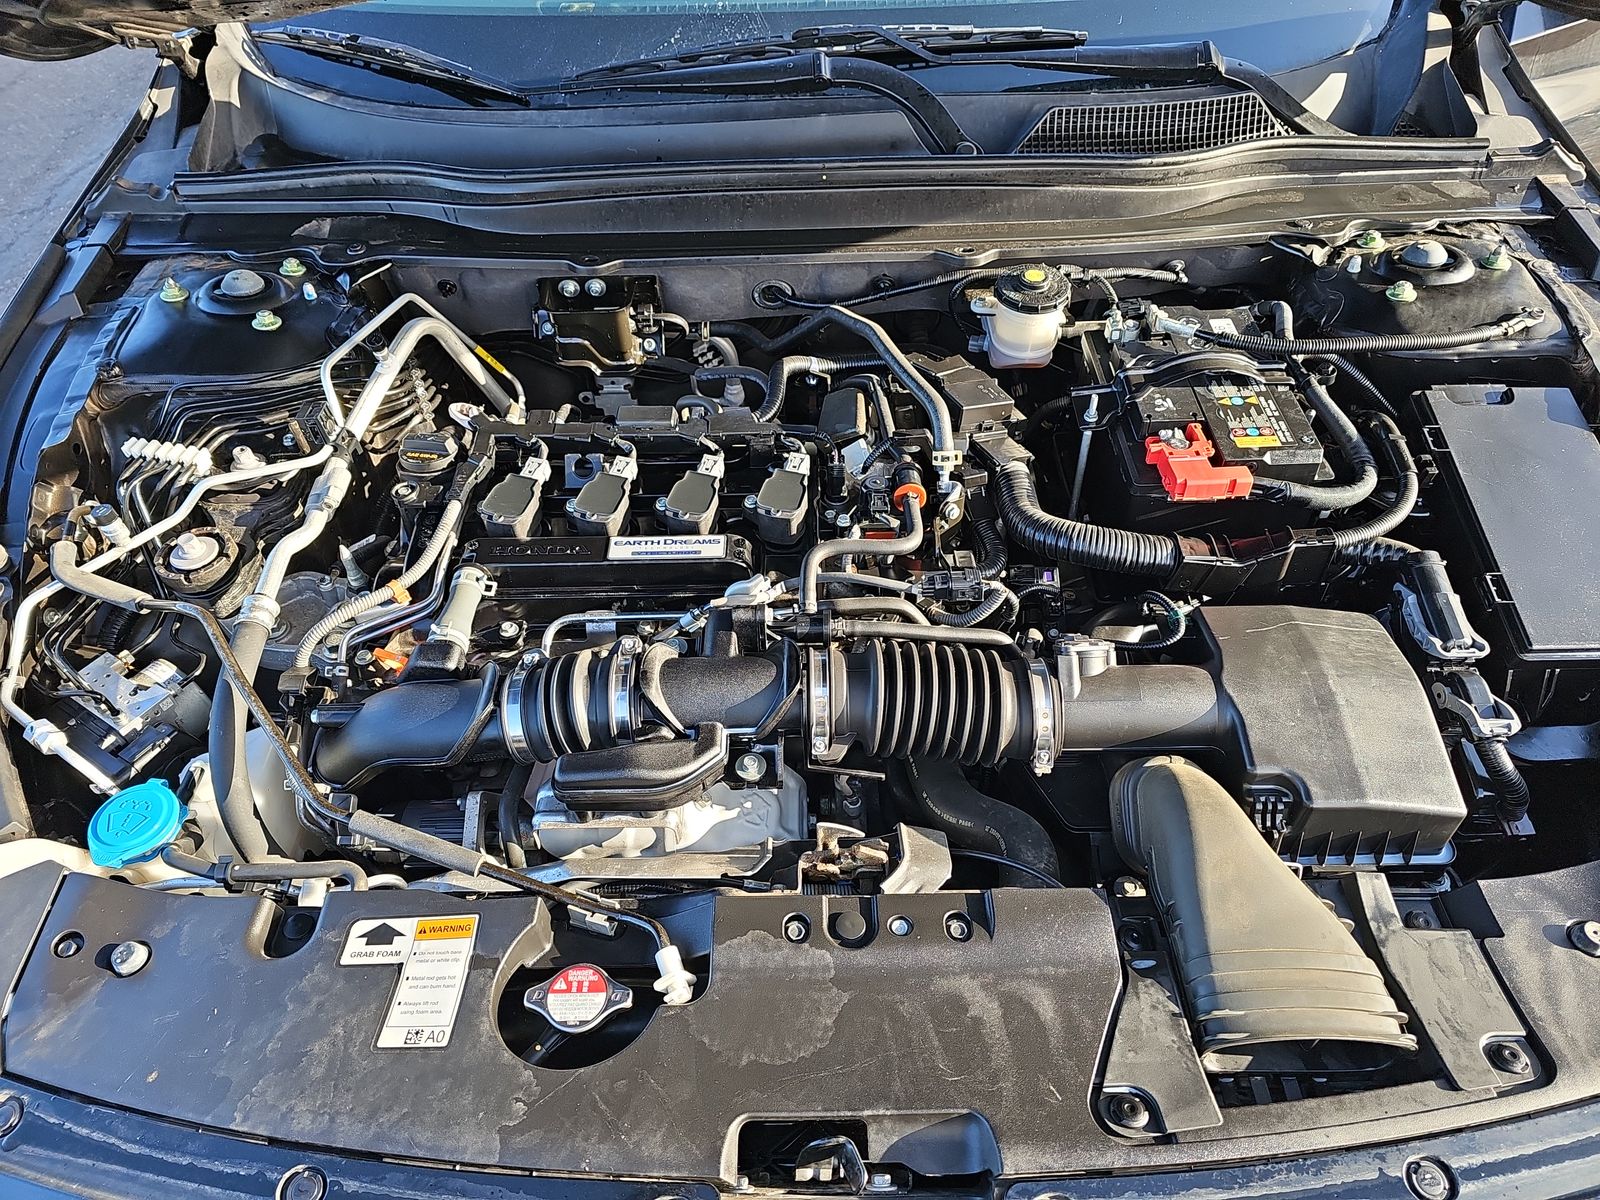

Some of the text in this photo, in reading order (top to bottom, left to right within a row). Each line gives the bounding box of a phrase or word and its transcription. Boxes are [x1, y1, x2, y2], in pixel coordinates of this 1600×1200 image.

[663, 538, 721, 546] DREAMS
[488, 544, 592, 556] HONDA
[428, 924, 472, 934] WARNING
[376, 950, 402, 958] FOAM
[424, 1030, 445, 1044] A0
